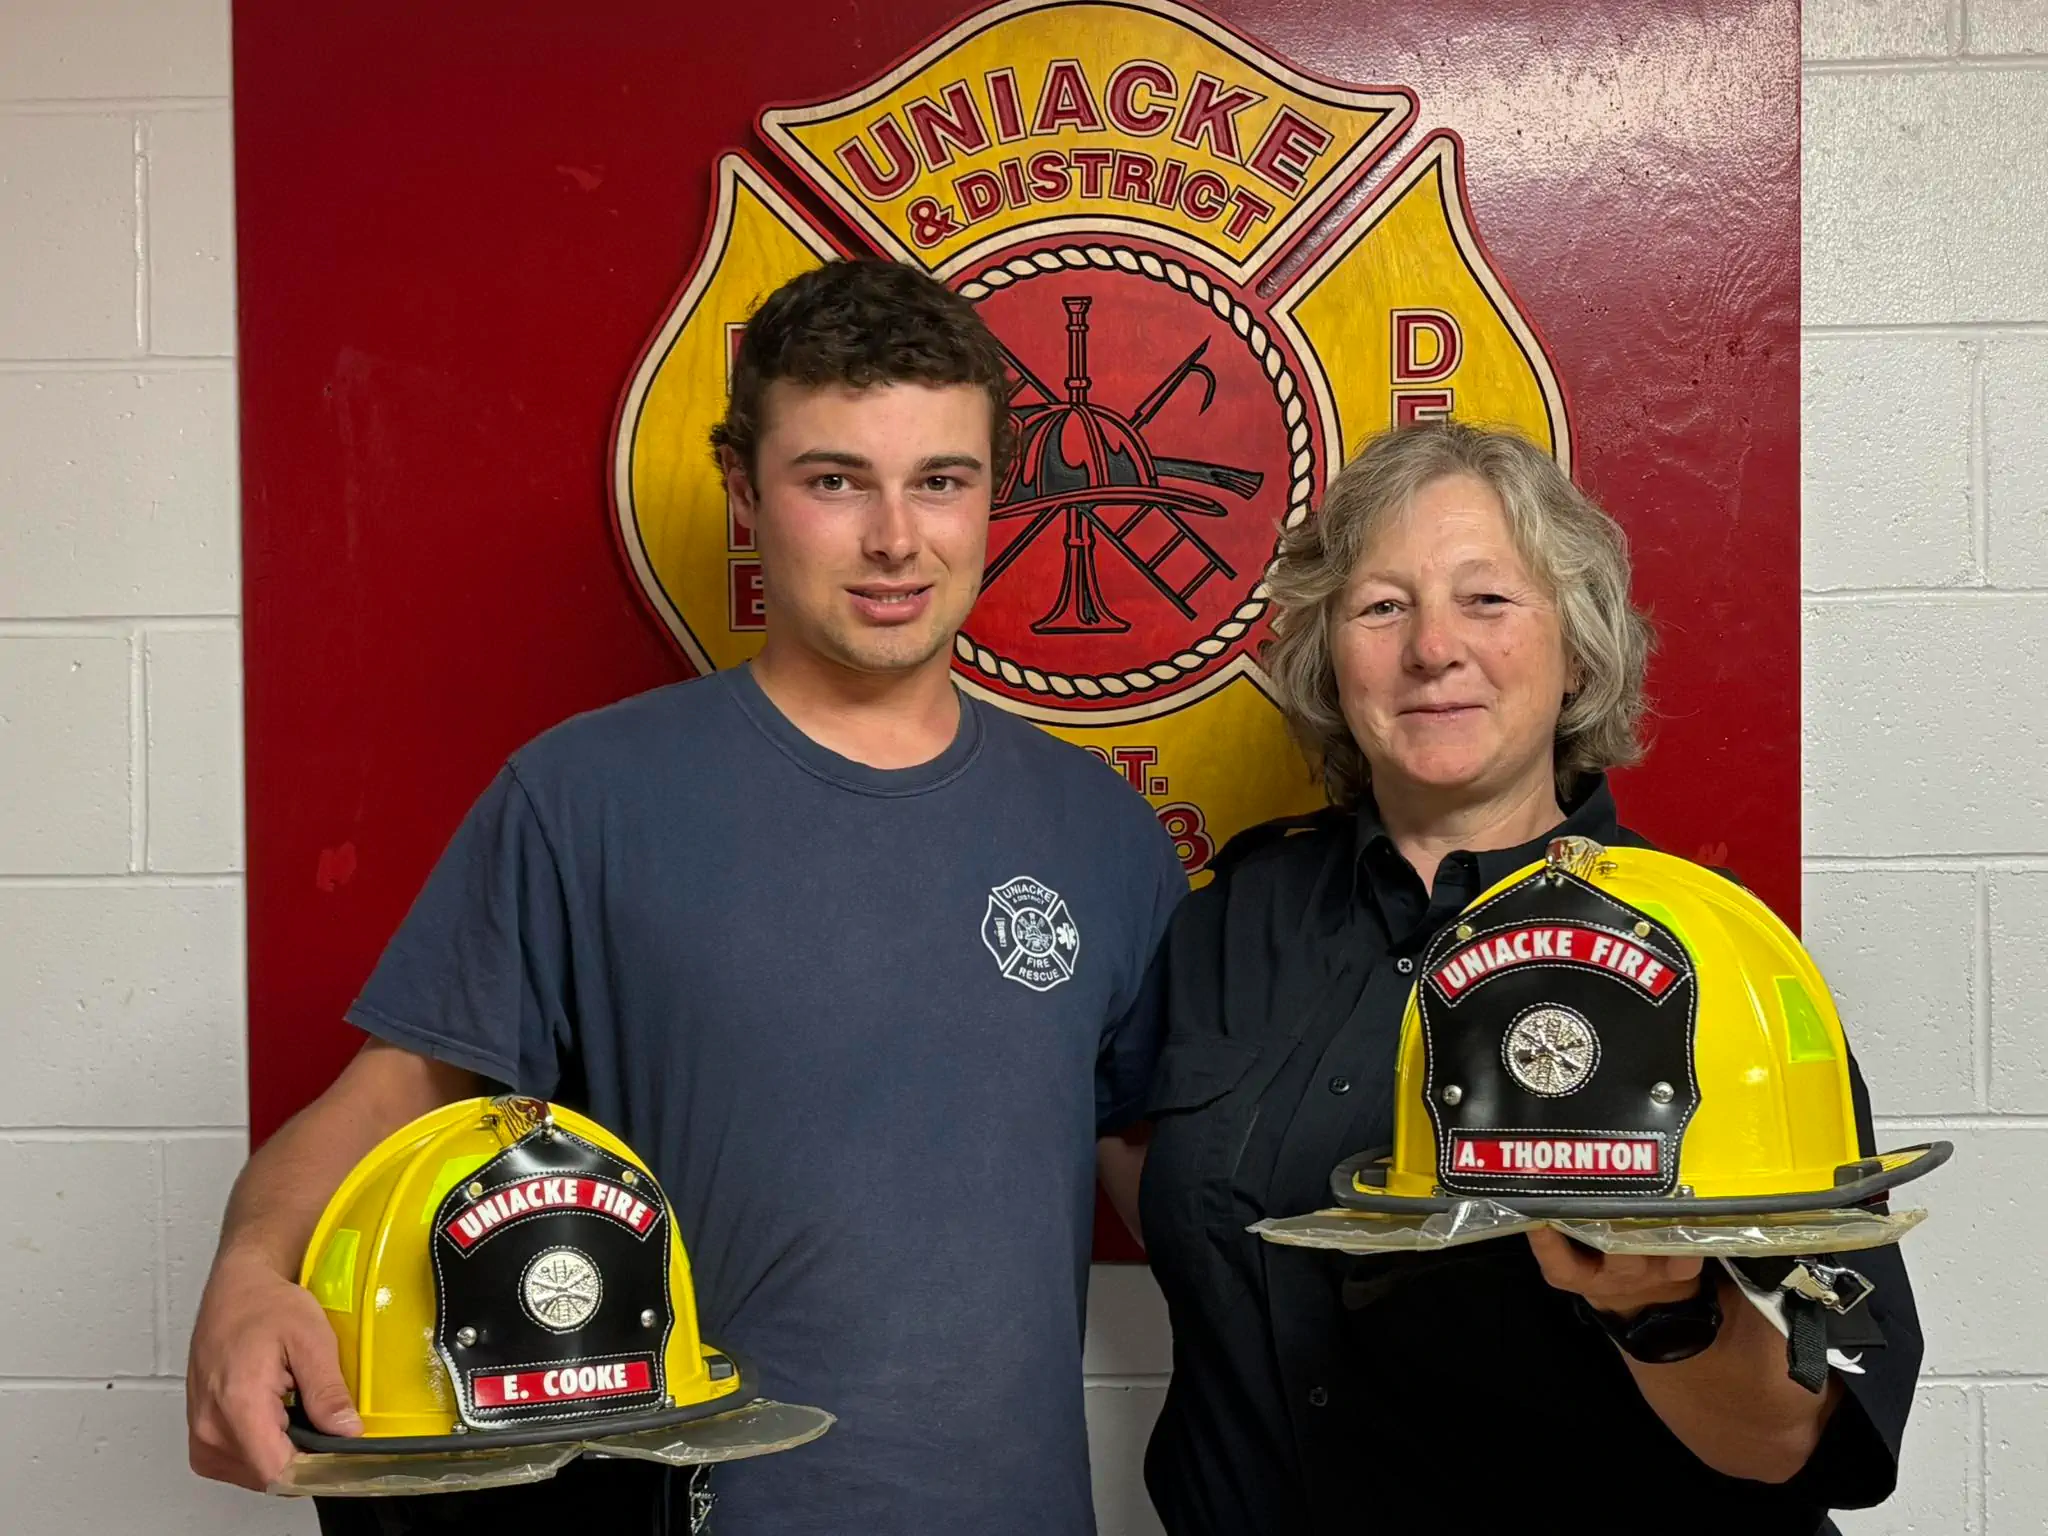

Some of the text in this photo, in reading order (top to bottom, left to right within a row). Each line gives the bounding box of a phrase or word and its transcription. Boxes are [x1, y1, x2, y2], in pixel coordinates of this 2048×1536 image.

[834, 58, 1335, 201] UNIACKE
[906, 148, 1277, 248] & DISTRICT
[1002, 883, 1052, 903] UNIACKE
[1018, 966, 1060, 982] RESCUE
[1026, 956, 1051, 969] FIRE
[1442, 930, 1666, 990] UNIACKE FIRE
[1458, 1141, 1652, 1171] A. THORNTON
[457, 1178, 648, 1239] UNIACKE FIRE
[503, 1363, 628, 1400] E. COOKE
